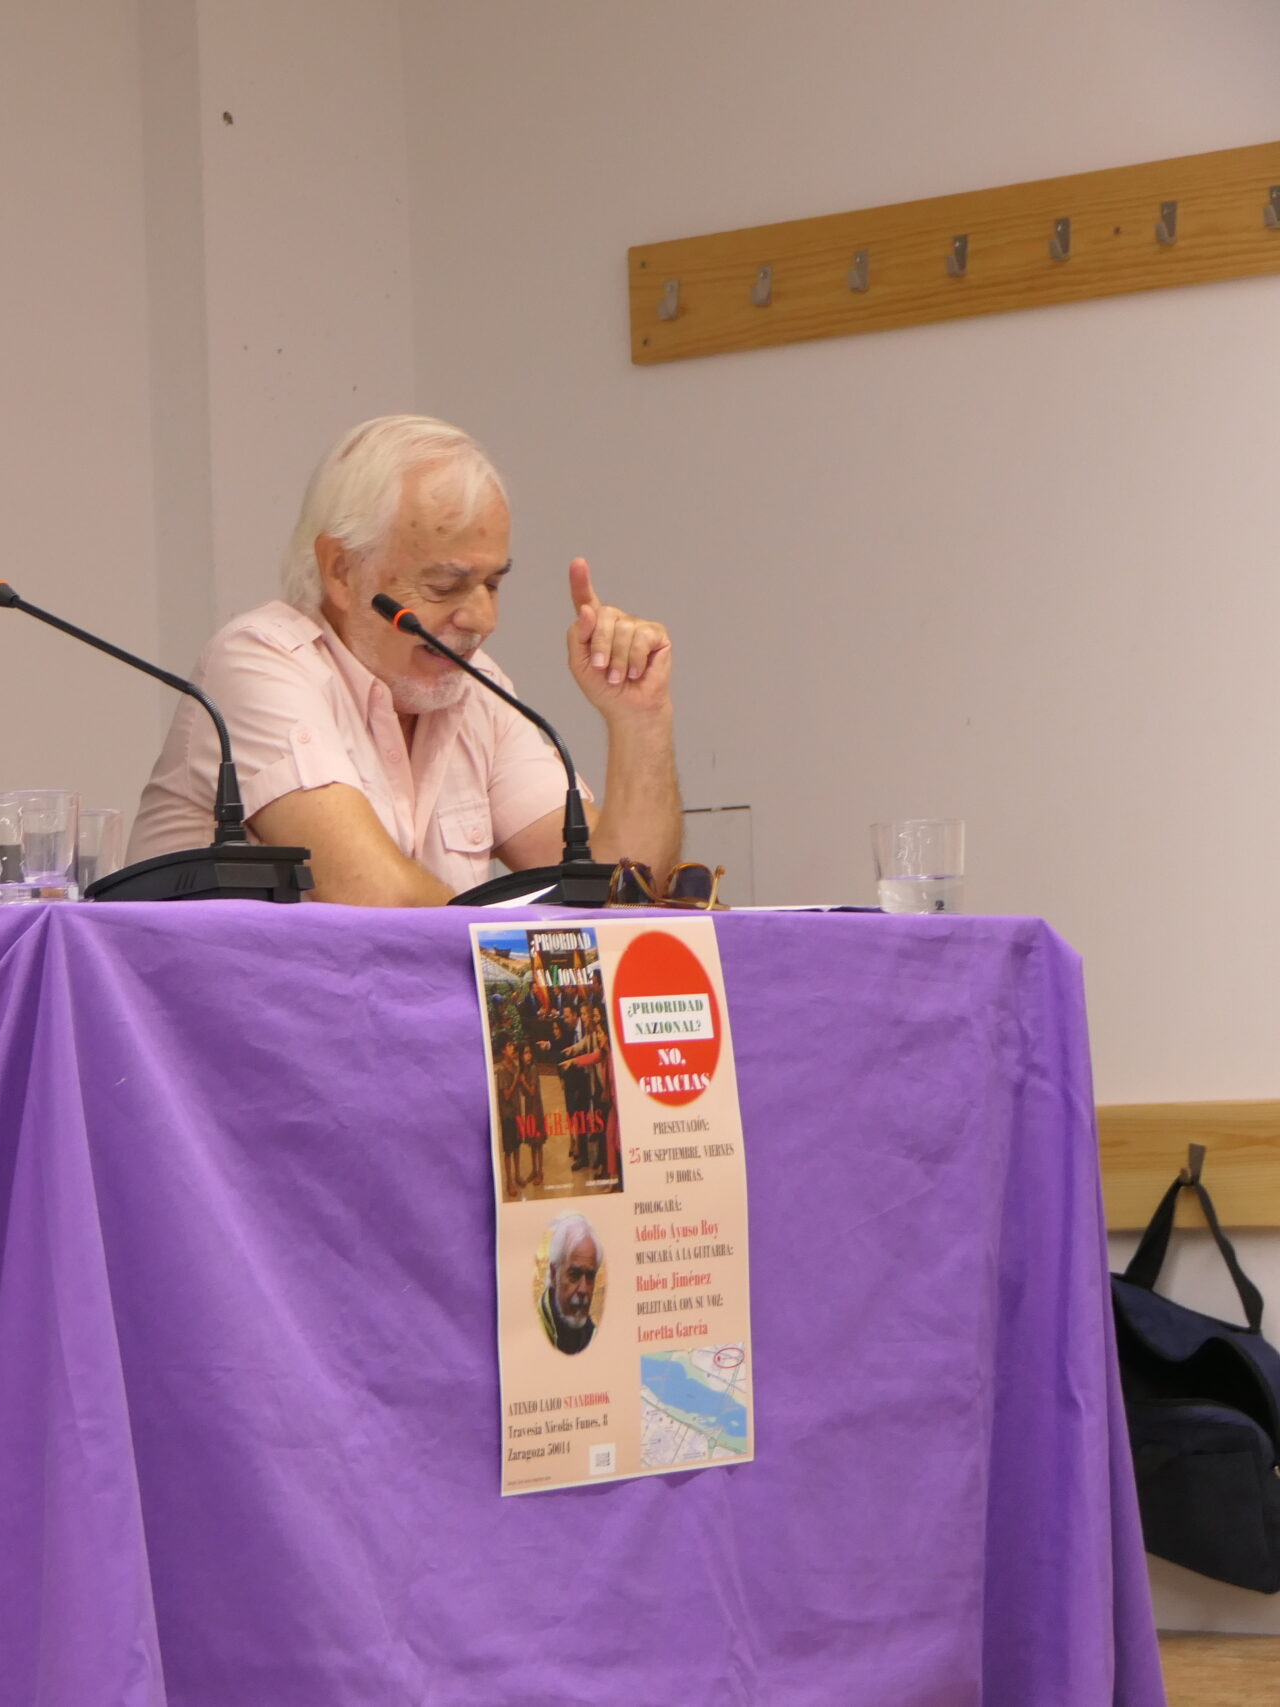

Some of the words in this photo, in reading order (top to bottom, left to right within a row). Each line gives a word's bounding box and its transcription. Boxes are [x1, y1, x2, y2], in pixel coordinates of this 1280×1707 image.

[530, 932, 591, 957] ¿PRIORIDAD
[627, 999, 704, 1018] ¿PRIORIDAD
[635, 1019, 702, 1036] NAZIONAL?
[639, 1072, 711, 1094] GRACIAS
[652, 1115, 710, 1135] PRESENTACIÓN:
[643, 1149, 652, 1163] DE
[703, 1143, 735, 1158] VIERNES
[665, 1170, 675, 1184] 19
[634, 1194, 682, 1216] PROLOGARÁ:
[635, 1223, 667, 1242] Adolfo
[670, 1223, 699, 1243] Ayuso
[700, 1219, 720, 1239] Roy
[635, 1245, 673, 1265] MUSICARÁ
[675, 1250, 681, 1261] A
[682, 1247, 692, 1261] LA
[693, 1243, 734, 1259] GUITARRA:
[636, 1272, 668, 1292] Rubén
[670, 1270, 712, 1290] Jiménez
[636, 1294, 678, 1315] DELEITARÁ
[679, 1297, 693, 1310] CON
[695, 1295, 704, 1309] SU
[706, 1293, 724, 1307] VOZ:
[675, 1319, 709, 1338] García
[508, 1400, 538, 1417] ATENEO
[539, 1397, 562, 1413] LAICO
[563, 1391, 610, 1408] STANBROOK
[544, 1418, 573, 1434] Nicolás
[507, 1447, 545, 1462] Zaragoza
